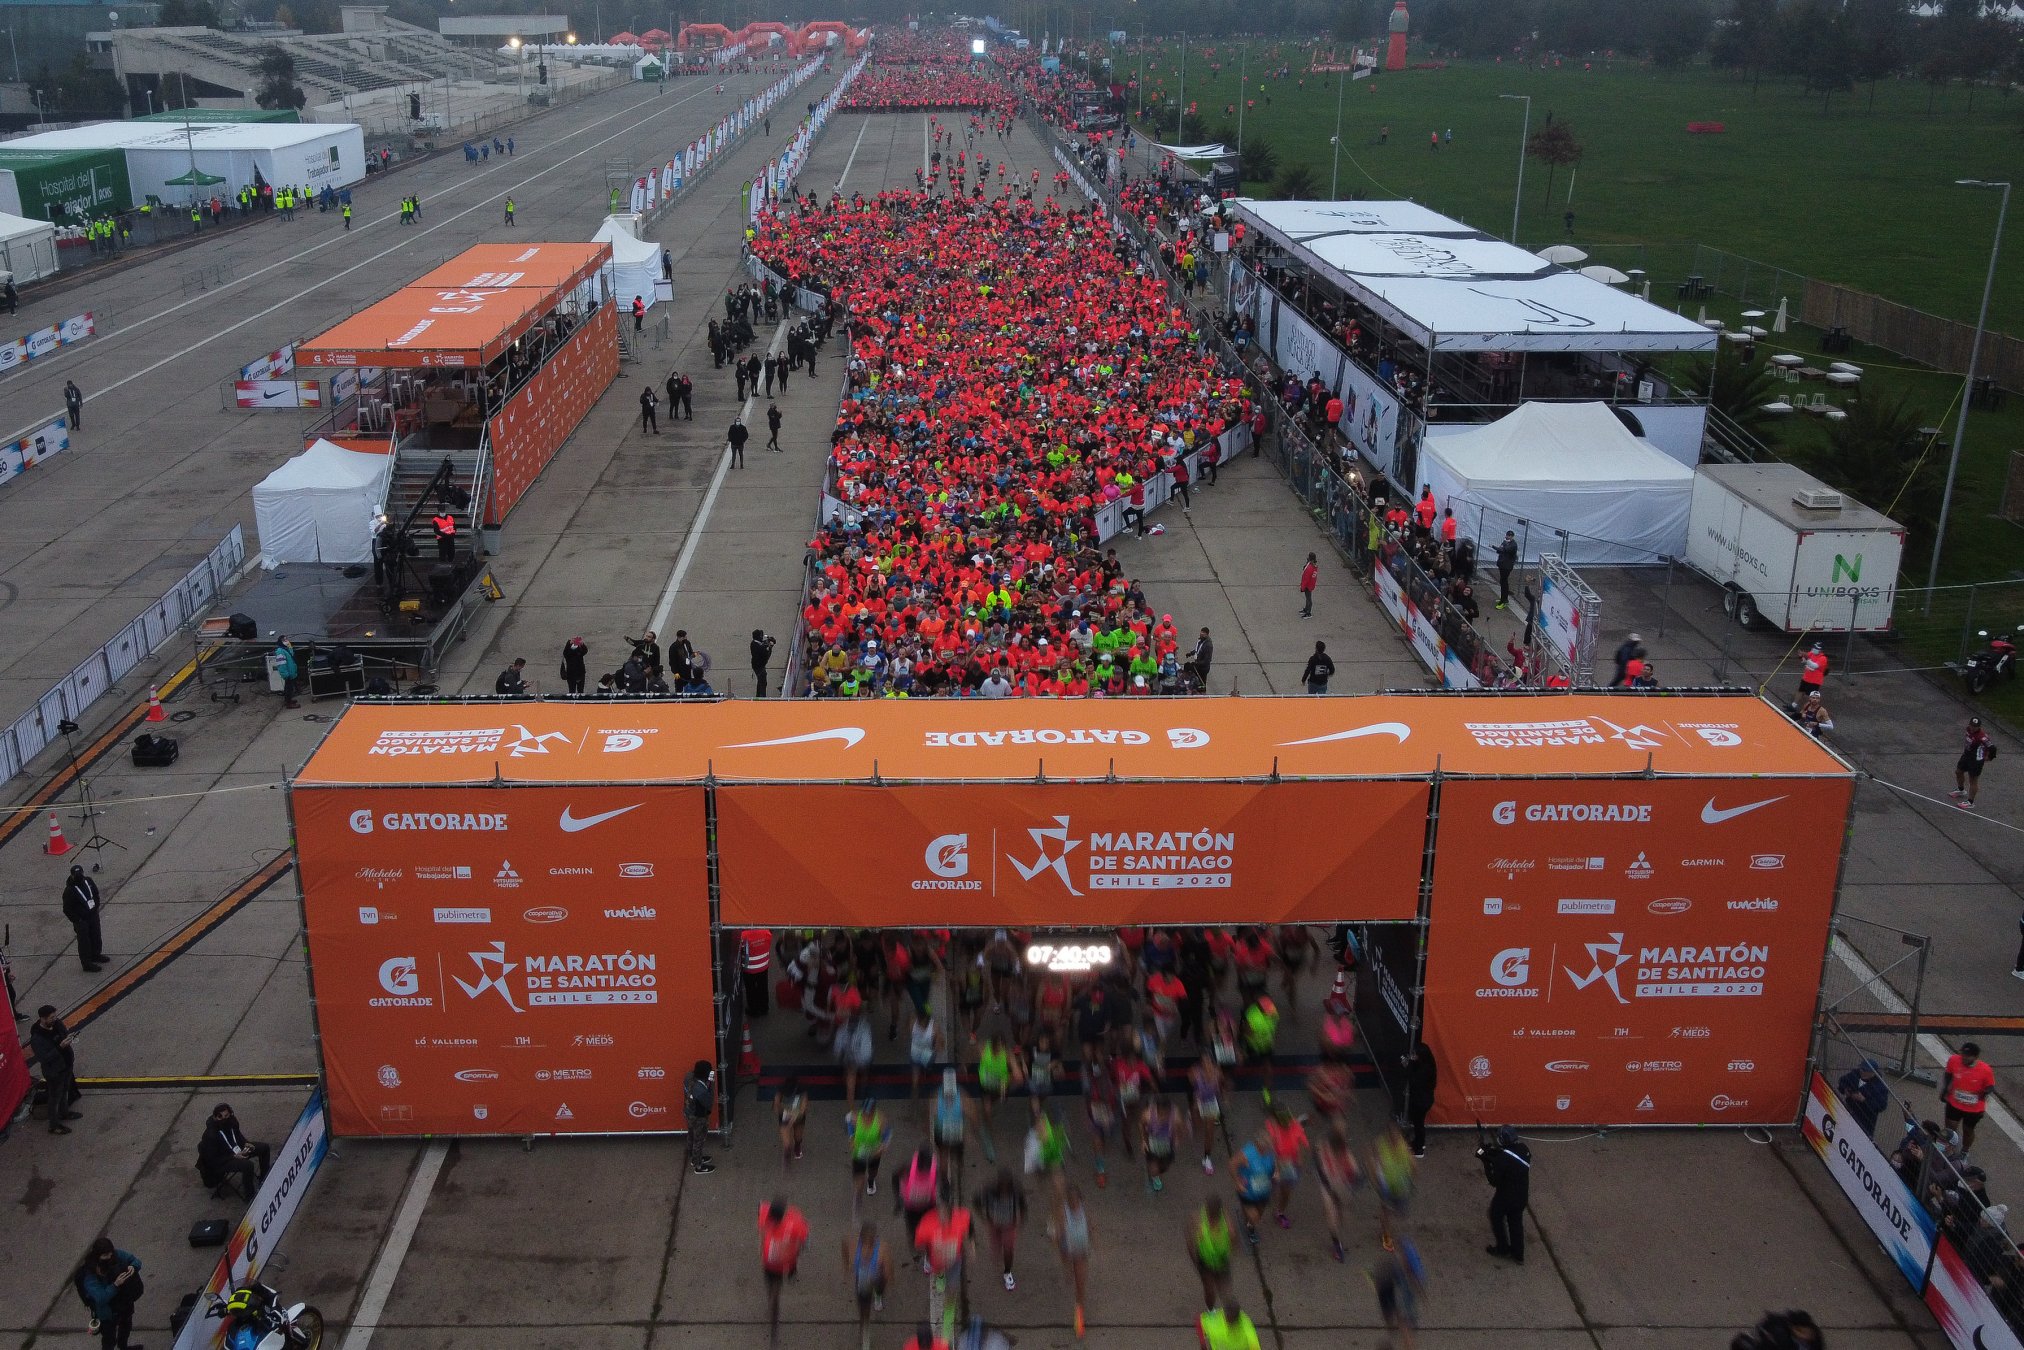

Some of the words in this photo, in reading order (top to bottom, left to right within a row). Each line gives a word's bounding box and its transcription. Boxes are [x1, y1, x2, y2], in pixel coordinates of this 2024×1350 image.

[40, 174, 76, 198] Hospital
[77, 169, 90, 189] del
[1707, 526, 1768, 578] WWW.UNIBOXS.CL
[1808, 586, 1880, 598] UNIBOXS
[1533, 720, 1584, 728] CHILE
[925, 730, 1150, 746] GATORADE
[1470, 729, 1571, 738] SANTIAGO
[376, 736, 476, 746] SANTIAGO
[478, 736, 500, 744] DE
[1475, 734, 1606, 748] MARATÓN
[368, 743, 498, 756] MARATÓN
[1525, 804, 1652, 822] GATORADE
[383, 813, 508, 831] GATORADE
[1090, 827, 1235, 851] MARATÓN
[1090, 856, 1118, 870] DE
[1123, 855, 1233, 870] SANTIAGO
[1488, 858, 1535, 869] Michelob
[1682, 858, 1724, 866] GARMIN
[355, 868, 402, 878] Michelob
[416, 872, 452, 880] Trabajador
[912, 880, 982, 890] GATORADE
[1096, 876, 1160, 886] CHILE
[1176, 876, 1228, 886] 2020
[1727, 898, 1779, 910] runchile
[604, 906, 656, 918] runchile
[1640, 942, 1768, 964] MARATÓN
[526, 950, 656, 973] MARATÓN
[1638, 968, 1662, 980] DE
[1667, 966, 1765, 980] SANTIAGO
[527, 976, 552, 990] DE
[557, 974, 657, 988] SANTIAGO
[1476, 988, 1539, 998] GATORADE
[1642, 986, 1700, 994] CHILE
[1713, 984, 1759, 994] 2020
[369, 997, 432, 1007] GATORADE
[534, 994, 593, 1004] CHILE
[607, 993, 654, 1002] 2020
[1727, 1062, 1754, 1070] STGO
[553, 1068, 592, 1076] METRO
[638, 1070, 665, 1078] STGO
[633, 1106, 666, 1114] Prokart
[260, 1132, 314, 1234] GATORADE
[1838, 1138, 1912, 1242] GATORADE
